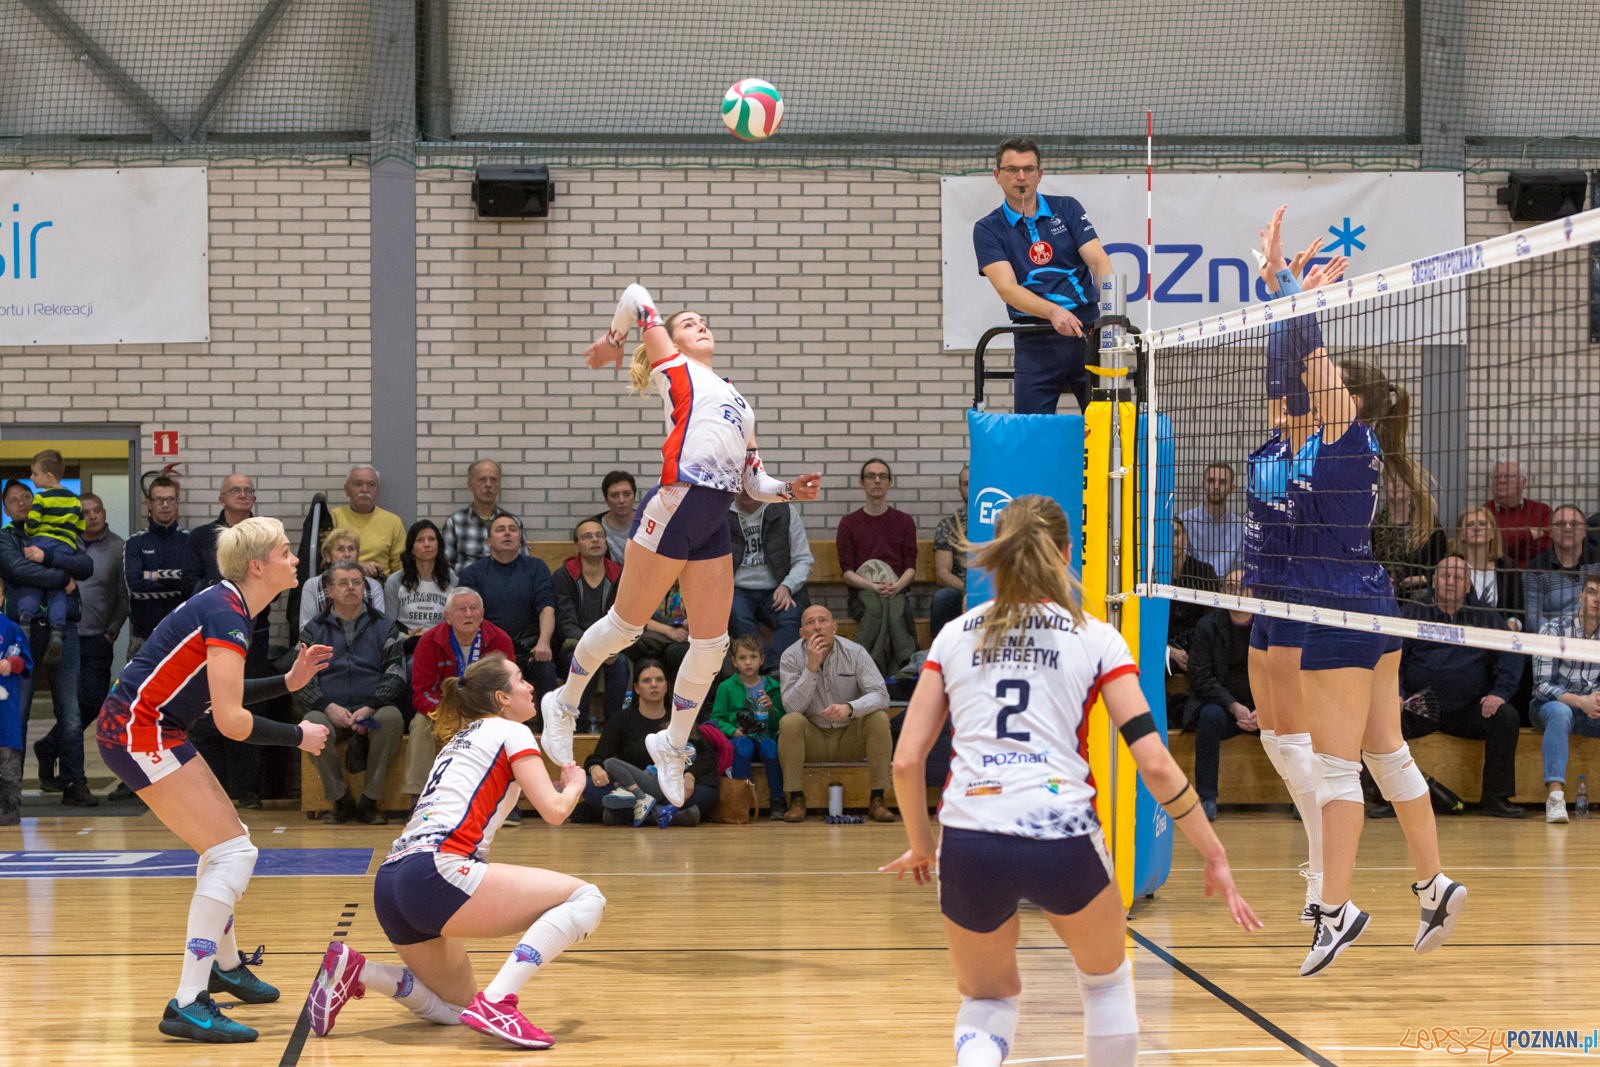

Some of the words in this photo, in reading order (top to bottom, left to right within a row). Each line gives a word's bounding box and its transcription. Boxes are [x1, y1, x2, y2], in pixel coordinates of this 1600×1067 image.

[27, 303, 30, 316] i
[34, 302, 93, 318] Rekreacji
[645, 519, 656, 536] 9
[408, 611, 443, 621] SEEKERS
[972, 648, 1060, 670] ENERGETYK
[996, 679, 1030, 742] 2
[422, 757, 453, 797] 8
